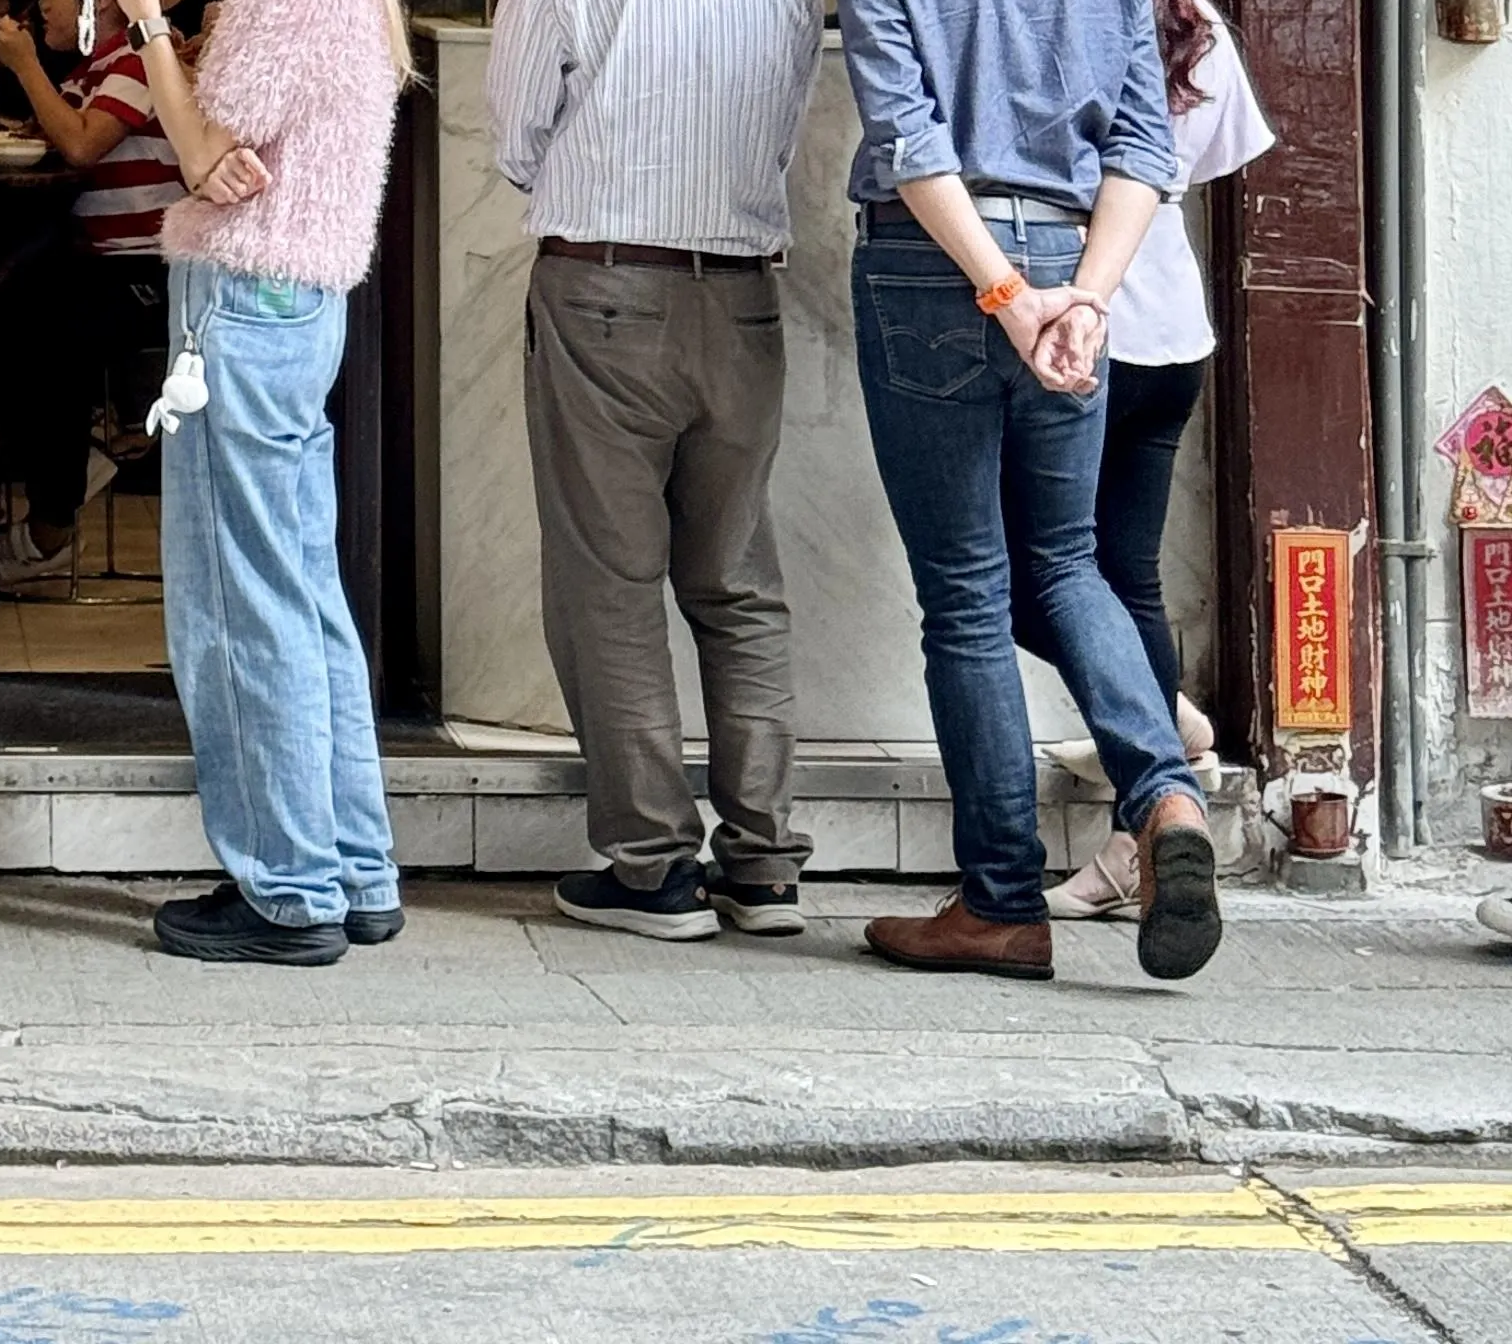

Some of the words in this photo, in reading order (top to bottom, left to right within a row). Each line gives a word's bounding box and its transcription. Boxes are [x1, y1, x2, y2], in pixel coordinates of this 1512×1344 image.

[1471, 415, 1512, 470] 福
[1296, 547, 1329, 699] 門口土地財神
